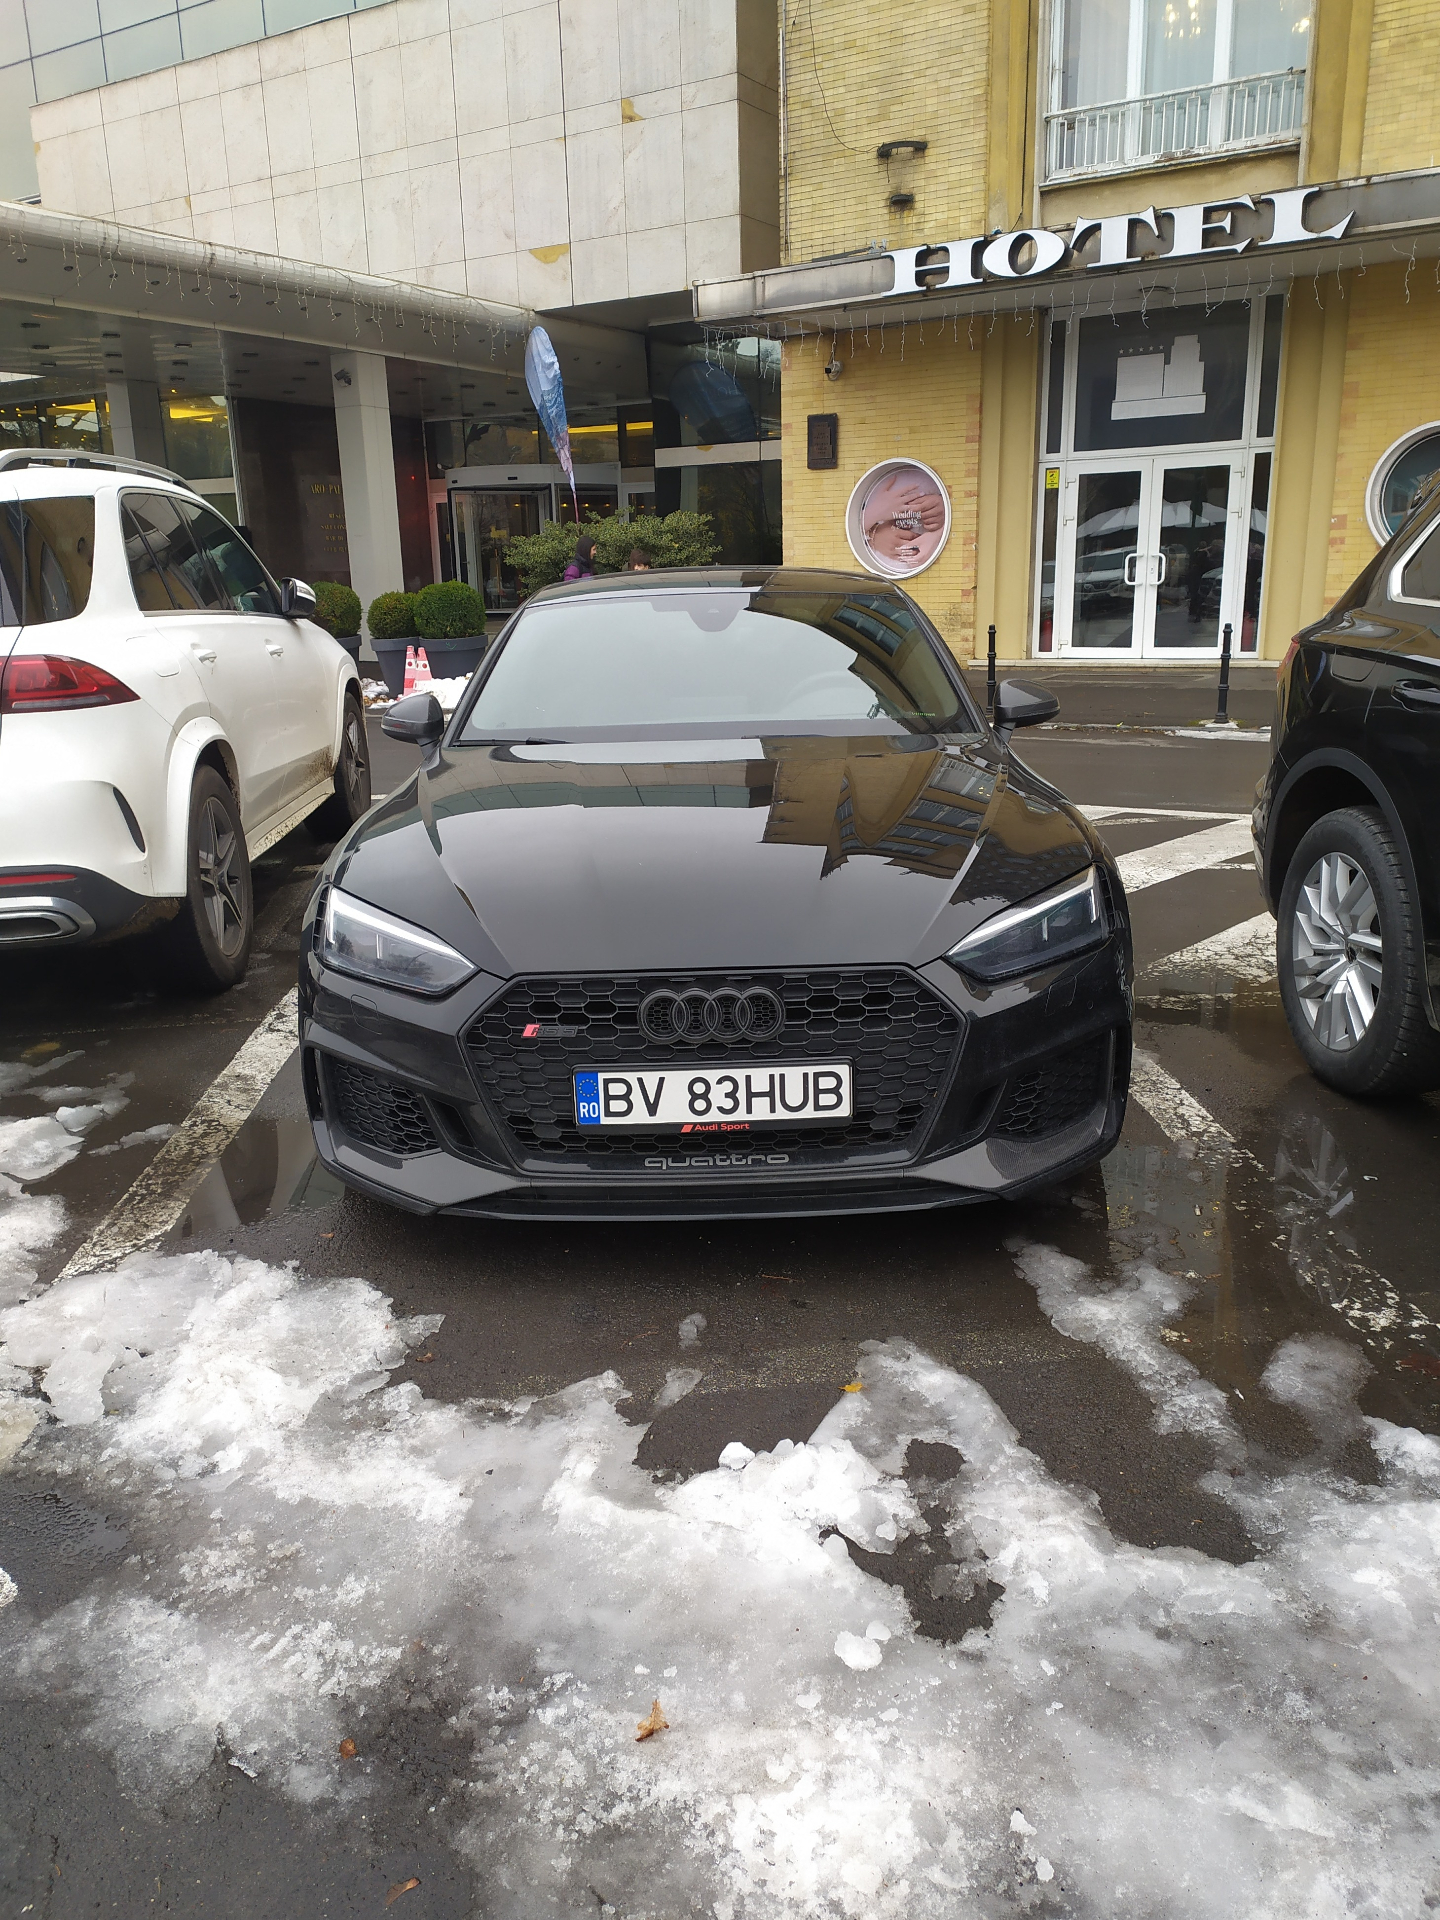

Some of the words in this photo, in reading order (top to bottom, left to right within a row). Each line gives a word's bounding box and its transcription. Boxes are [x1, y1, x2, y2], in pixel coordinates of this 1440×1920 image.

[881, 187, 1356, 297] HOTEL
[892, 510, 922, 519] Wedding
[895, 518, 918, 526] events
[602, 1076, 666, 1118] BV
[687, 1070, 844, 1117] 83HUB
[580, 1102, 599, 1118] RO
[694, 1123, 718, 1131] Audi
[720, 1122, 750, 1131] Sport
[644, 1153, 790, 1170] quattro
